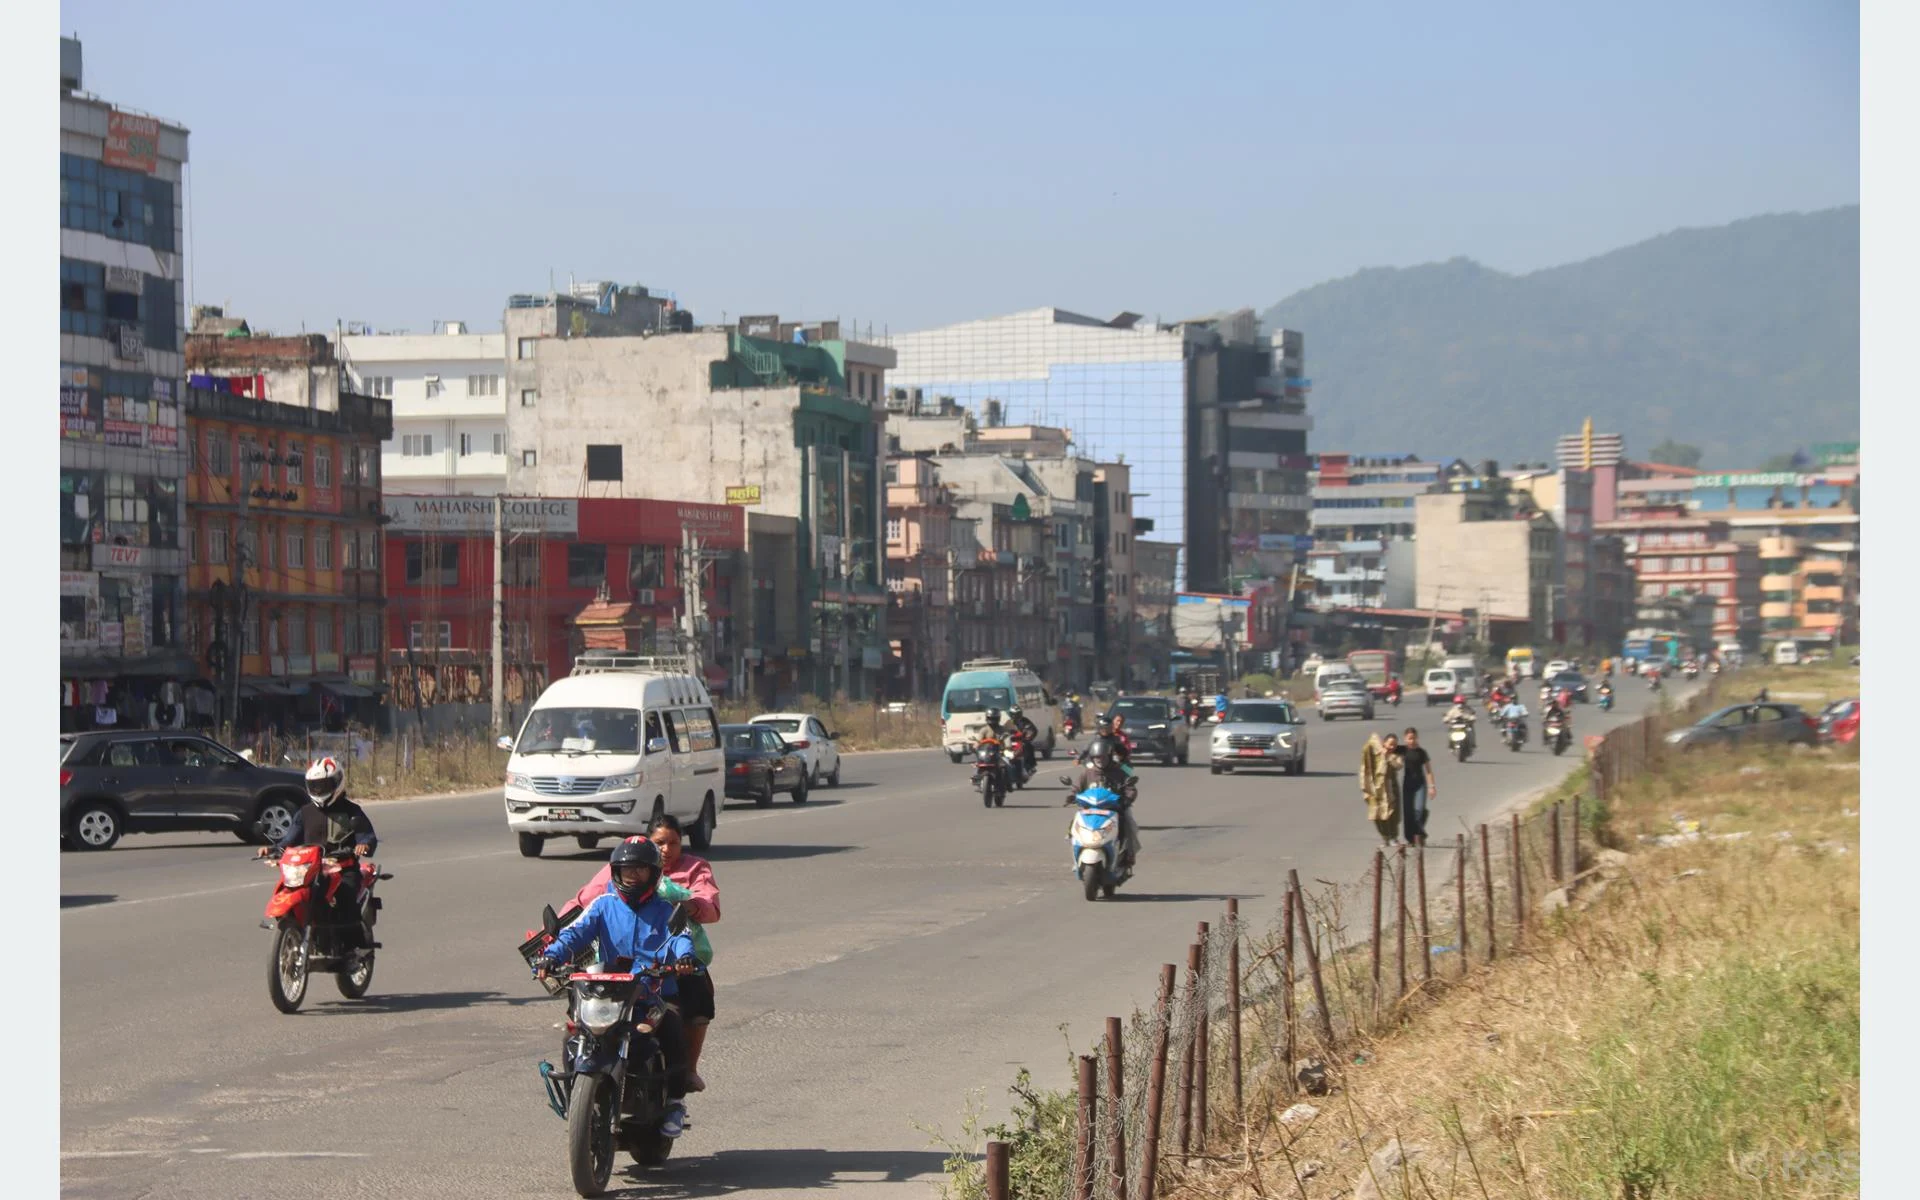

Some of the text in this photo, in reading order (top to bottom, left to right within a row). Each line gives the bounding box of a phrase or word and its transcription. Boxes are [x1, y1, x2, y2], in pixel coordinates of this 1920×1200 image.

[122, 114, 157, 135] HEAVEN
[121, 270, 138, 281] SPA
[123, 336, 145, 354] SPA
[413, 500, 568, 516] MAHARSHI COLLEGE
[111, 547, 140, 563] TEVT
